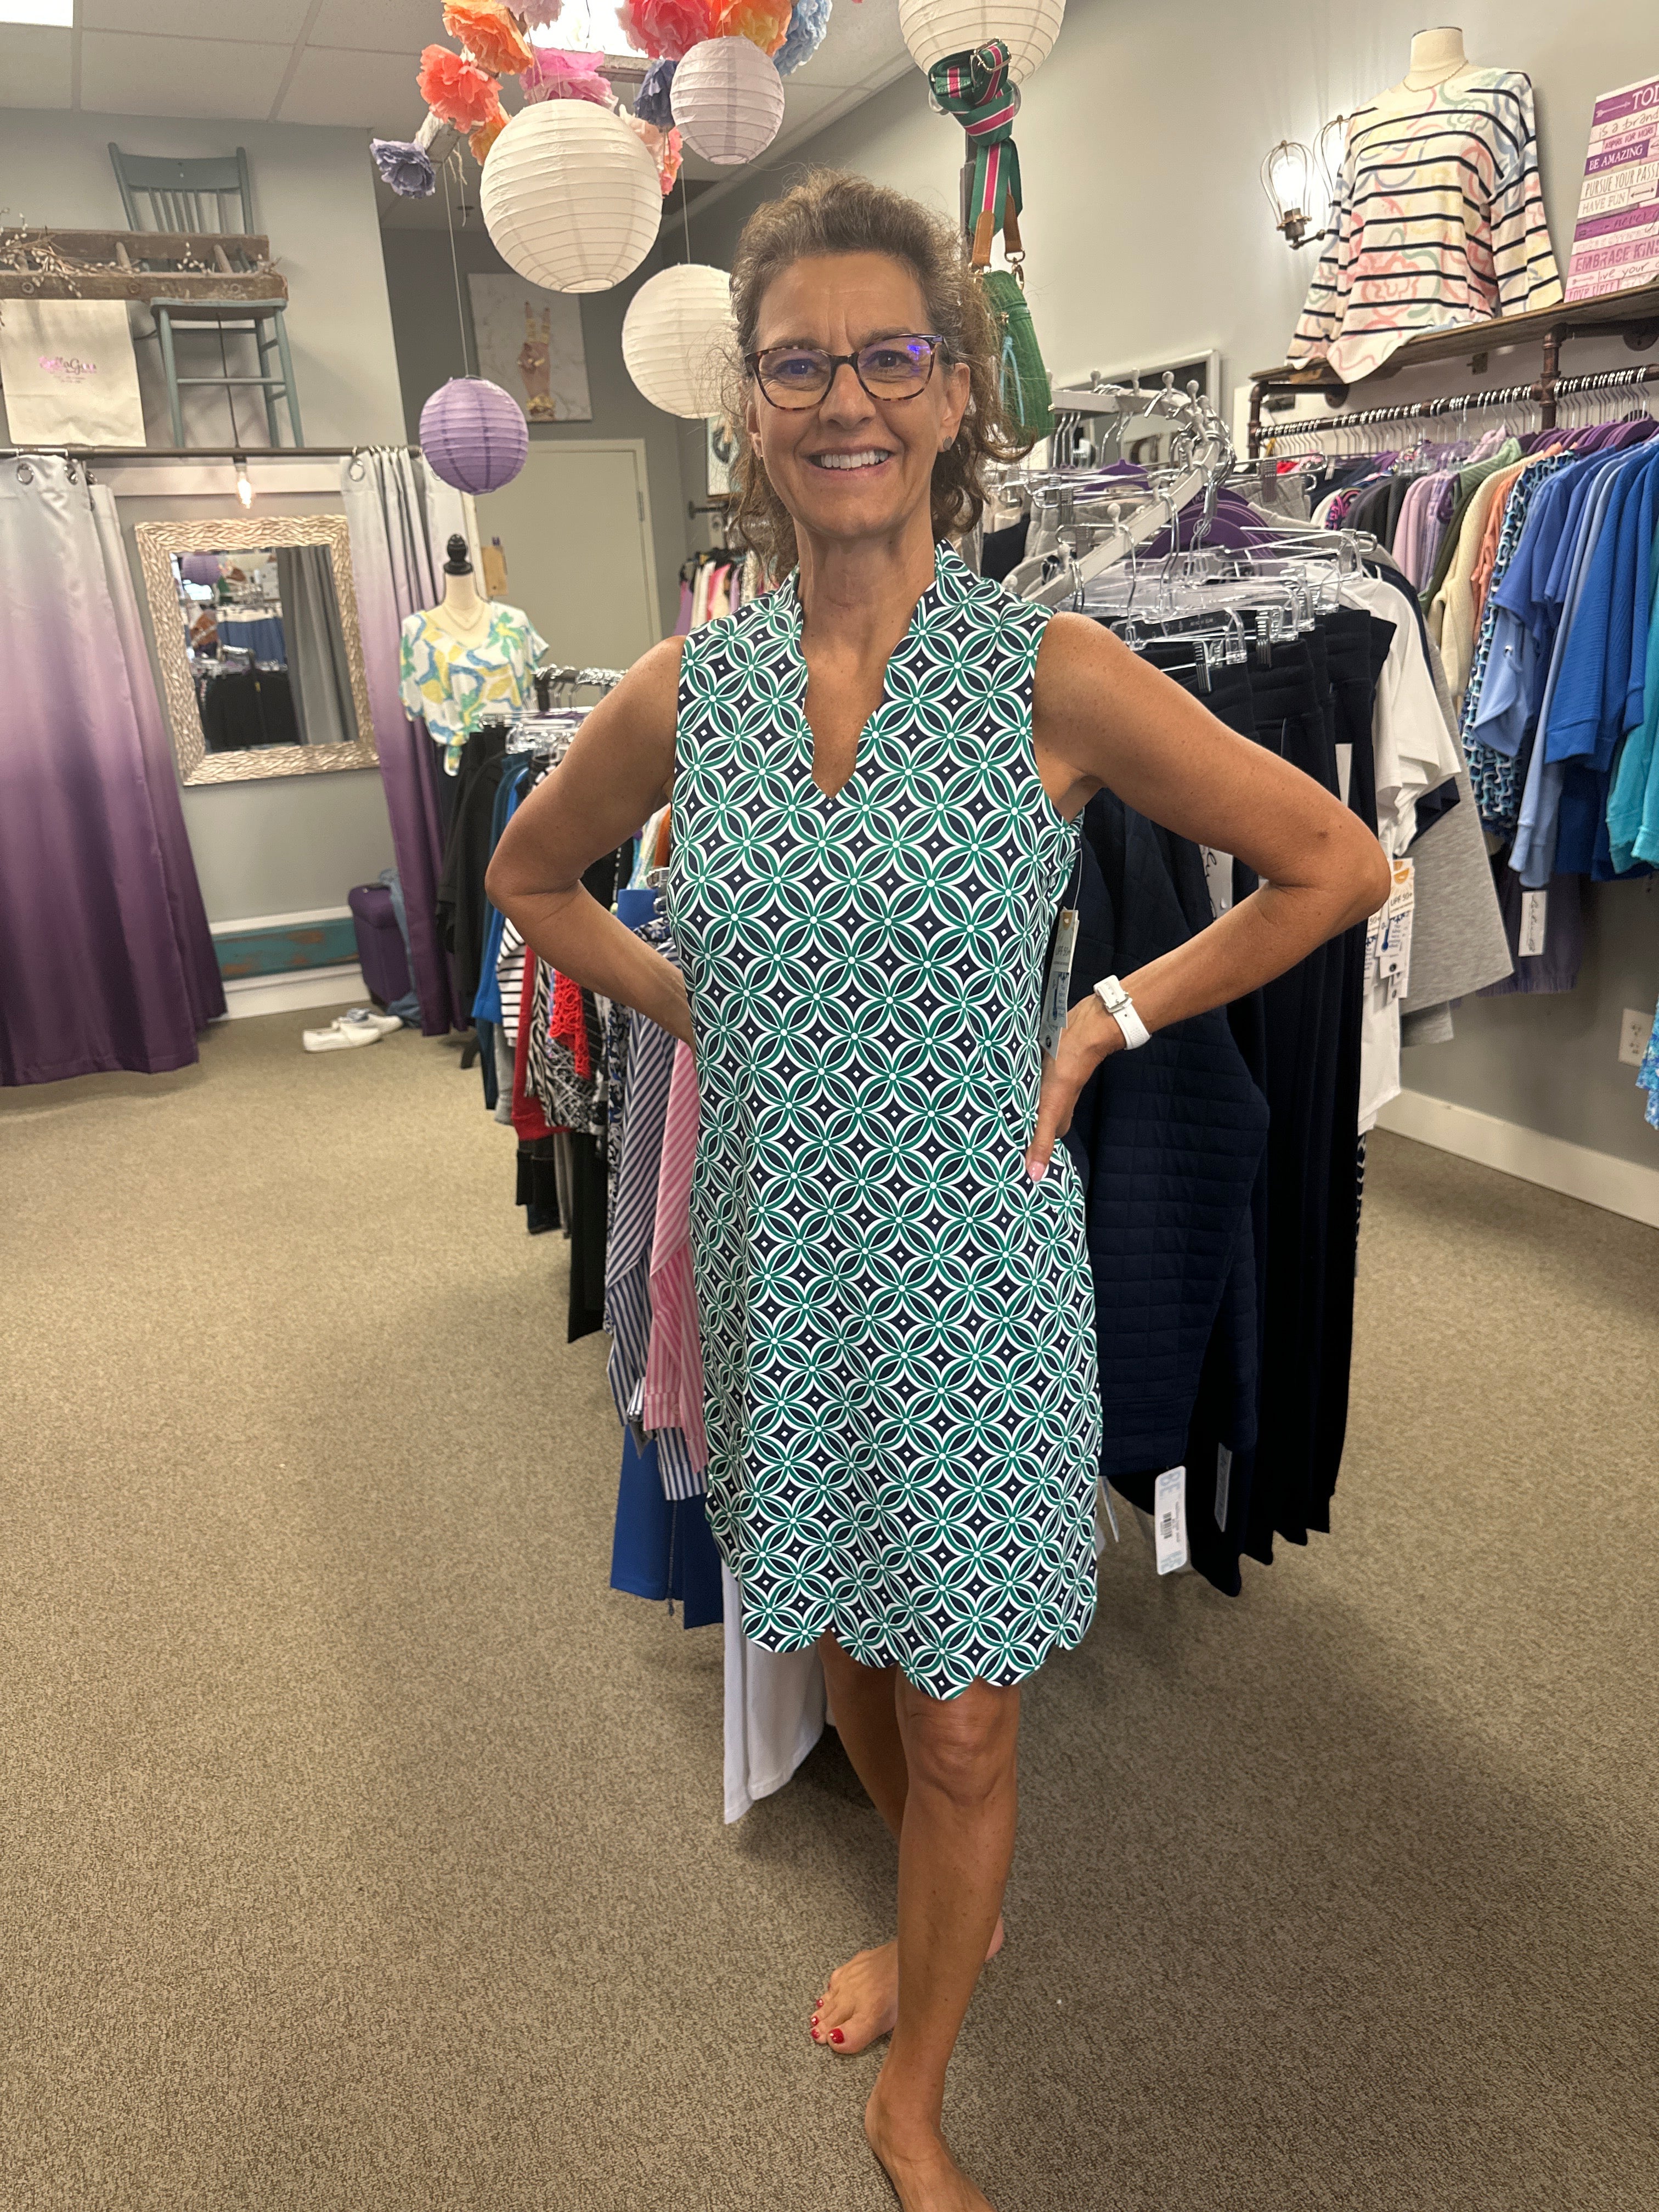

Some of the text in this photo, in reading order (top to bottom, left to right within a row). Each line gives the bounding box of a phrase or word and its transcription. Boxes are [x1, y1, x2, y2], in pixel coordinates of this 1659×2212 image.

[1637, 126, 1654, 139] MORE
[1589, 144, 1643, 171] BE AMAZING
[1585, 176, 1613, 198] PURSUE
[1615, 169, 1635, 189] YOUR
[1582, 191, 1626, 215] HAVE FUN
[1575, 246, 1631, 273] EMBRACE
[1598, 268, 1616, 283] live
[1622, 261, 1650, 281] your
